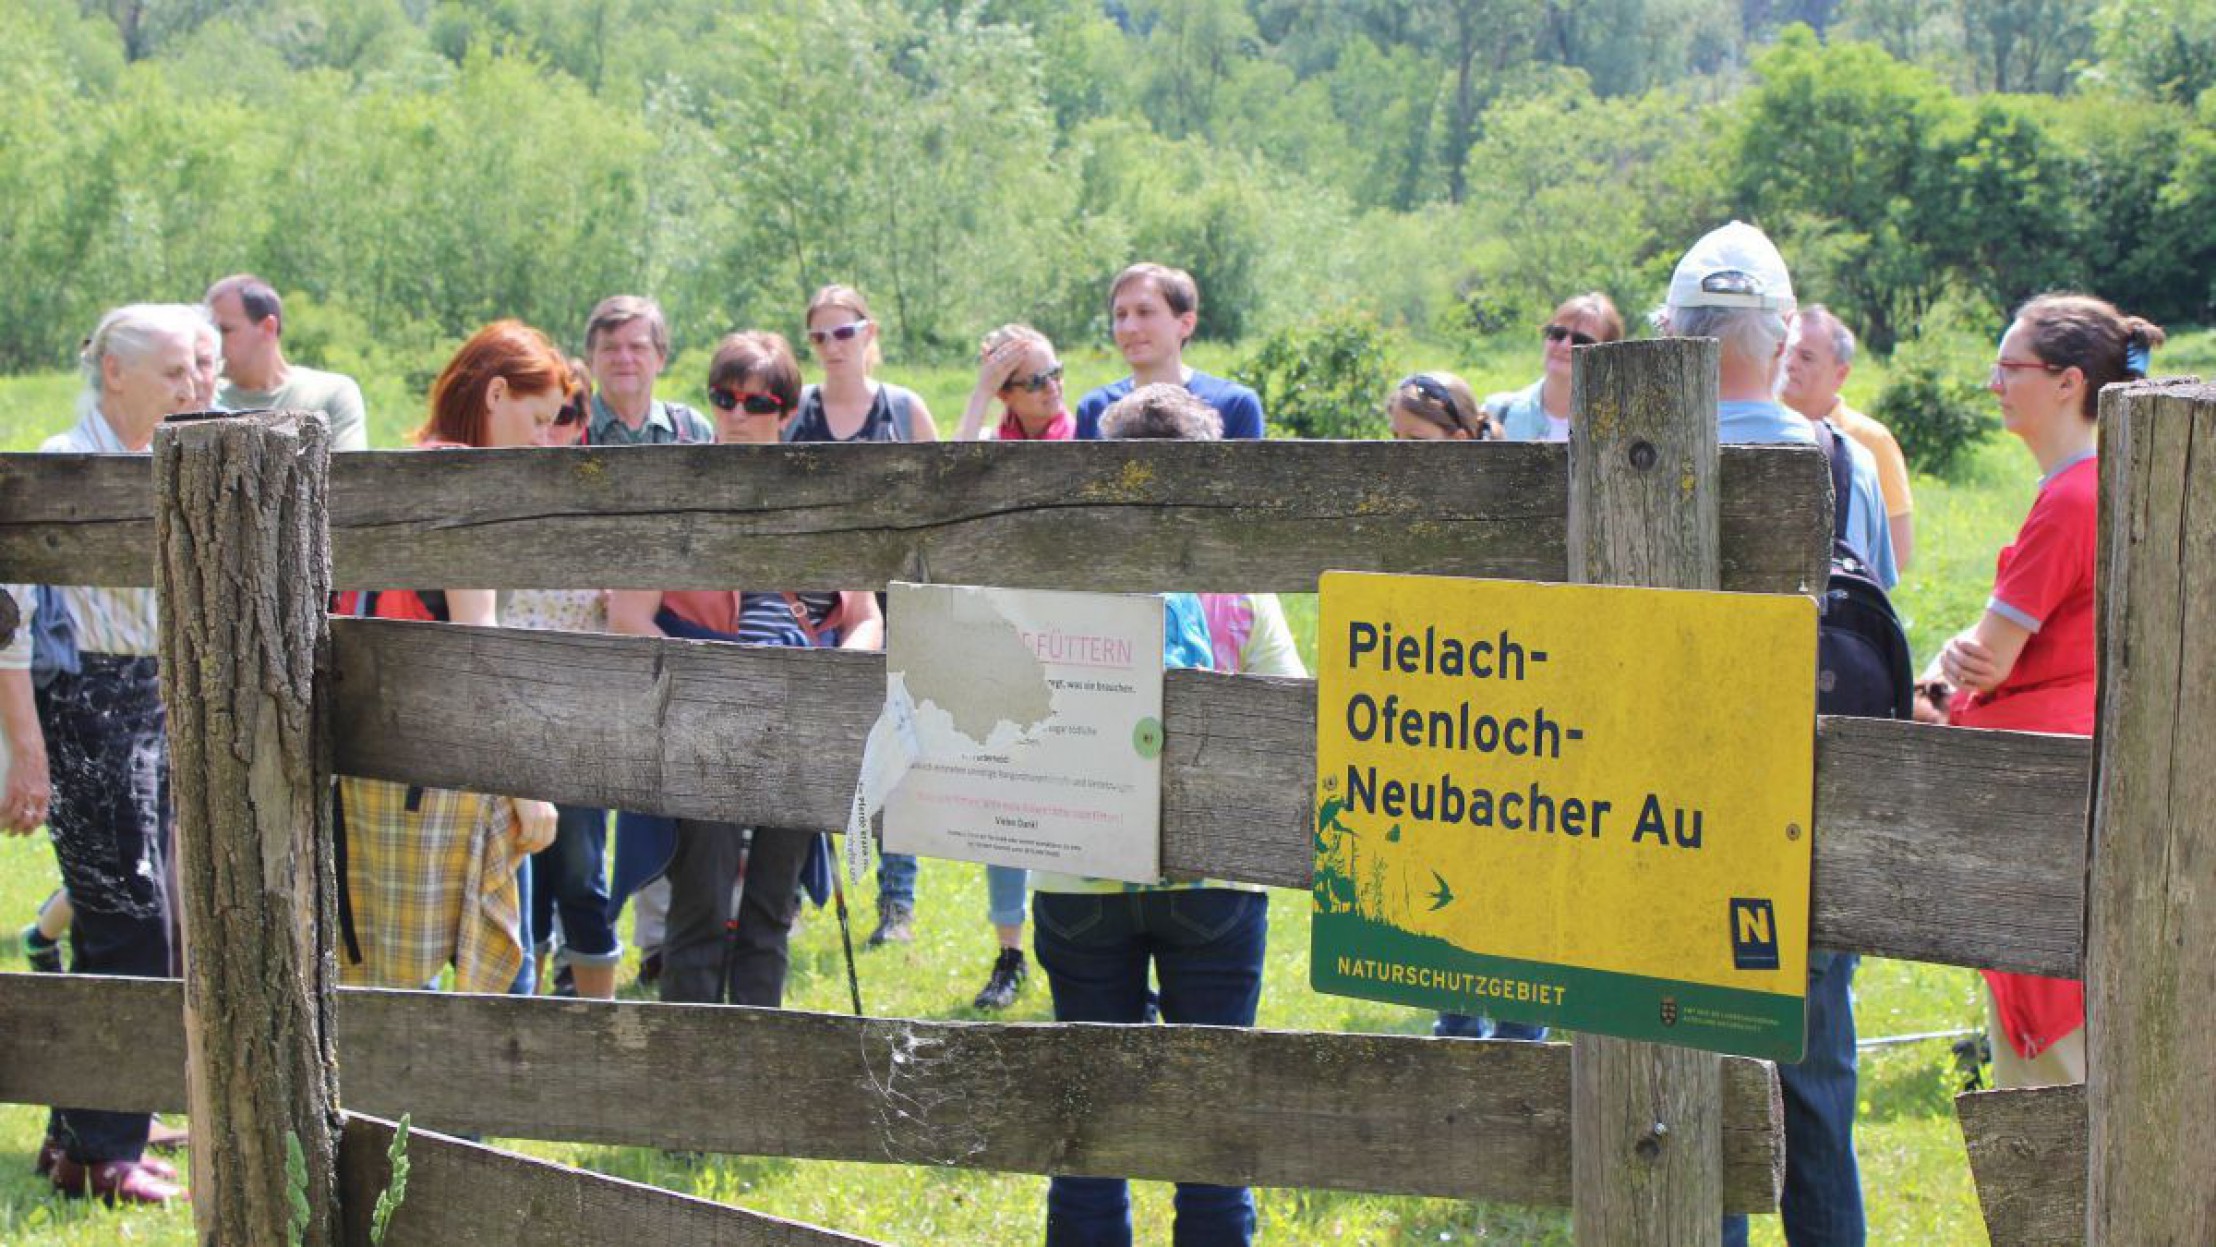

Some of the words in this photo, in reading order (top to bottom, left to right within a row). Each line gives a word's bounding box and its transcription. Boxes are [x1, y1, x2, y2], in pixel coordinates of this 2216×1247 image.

[1037, 629, 1131, 664] FÜTTERN
[1348, 620, 1548, 681] Pielach-
[1346, 693, 1584, 759] Ofenloch-
[1345, 764, 1611, 839] Neubacher
[1632, 793, 1703, 850] Au
[1737, 906, 1772, 943] N
[1337, 956, 1566, 1006] NATURSCHUTZGEBIET
